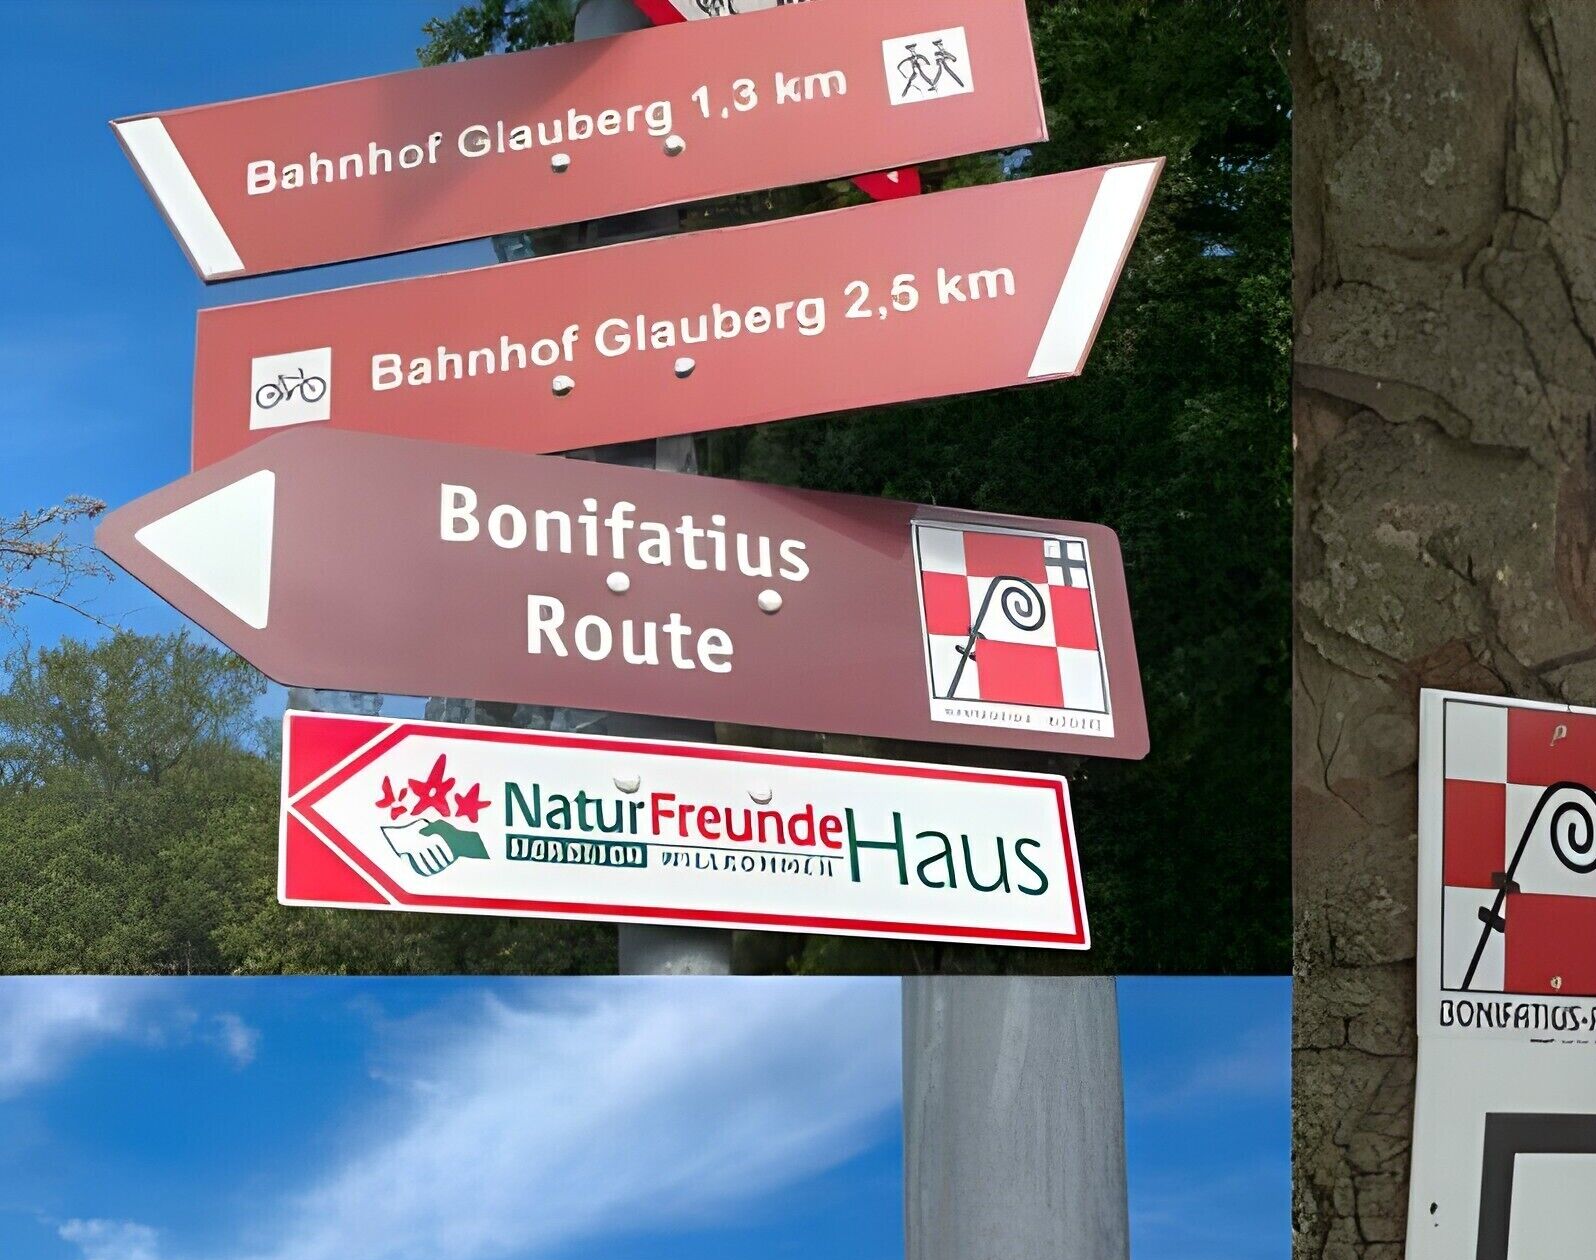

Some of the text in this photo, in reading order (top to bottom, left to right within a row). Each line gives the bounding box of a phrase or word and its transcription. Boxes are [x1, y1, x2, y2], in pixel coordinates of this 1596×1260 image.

[247, 70, 847, 196] Bahnhof Glauberg 1,3 km
[371, 323, 580, 391] Bahnhof
[595, 297, 826, 357] Glauberg
[937, 267, 1016, 305] km
[440, 482, 810, 582] Bonifatius
[527, 594, 734, 674] Route
